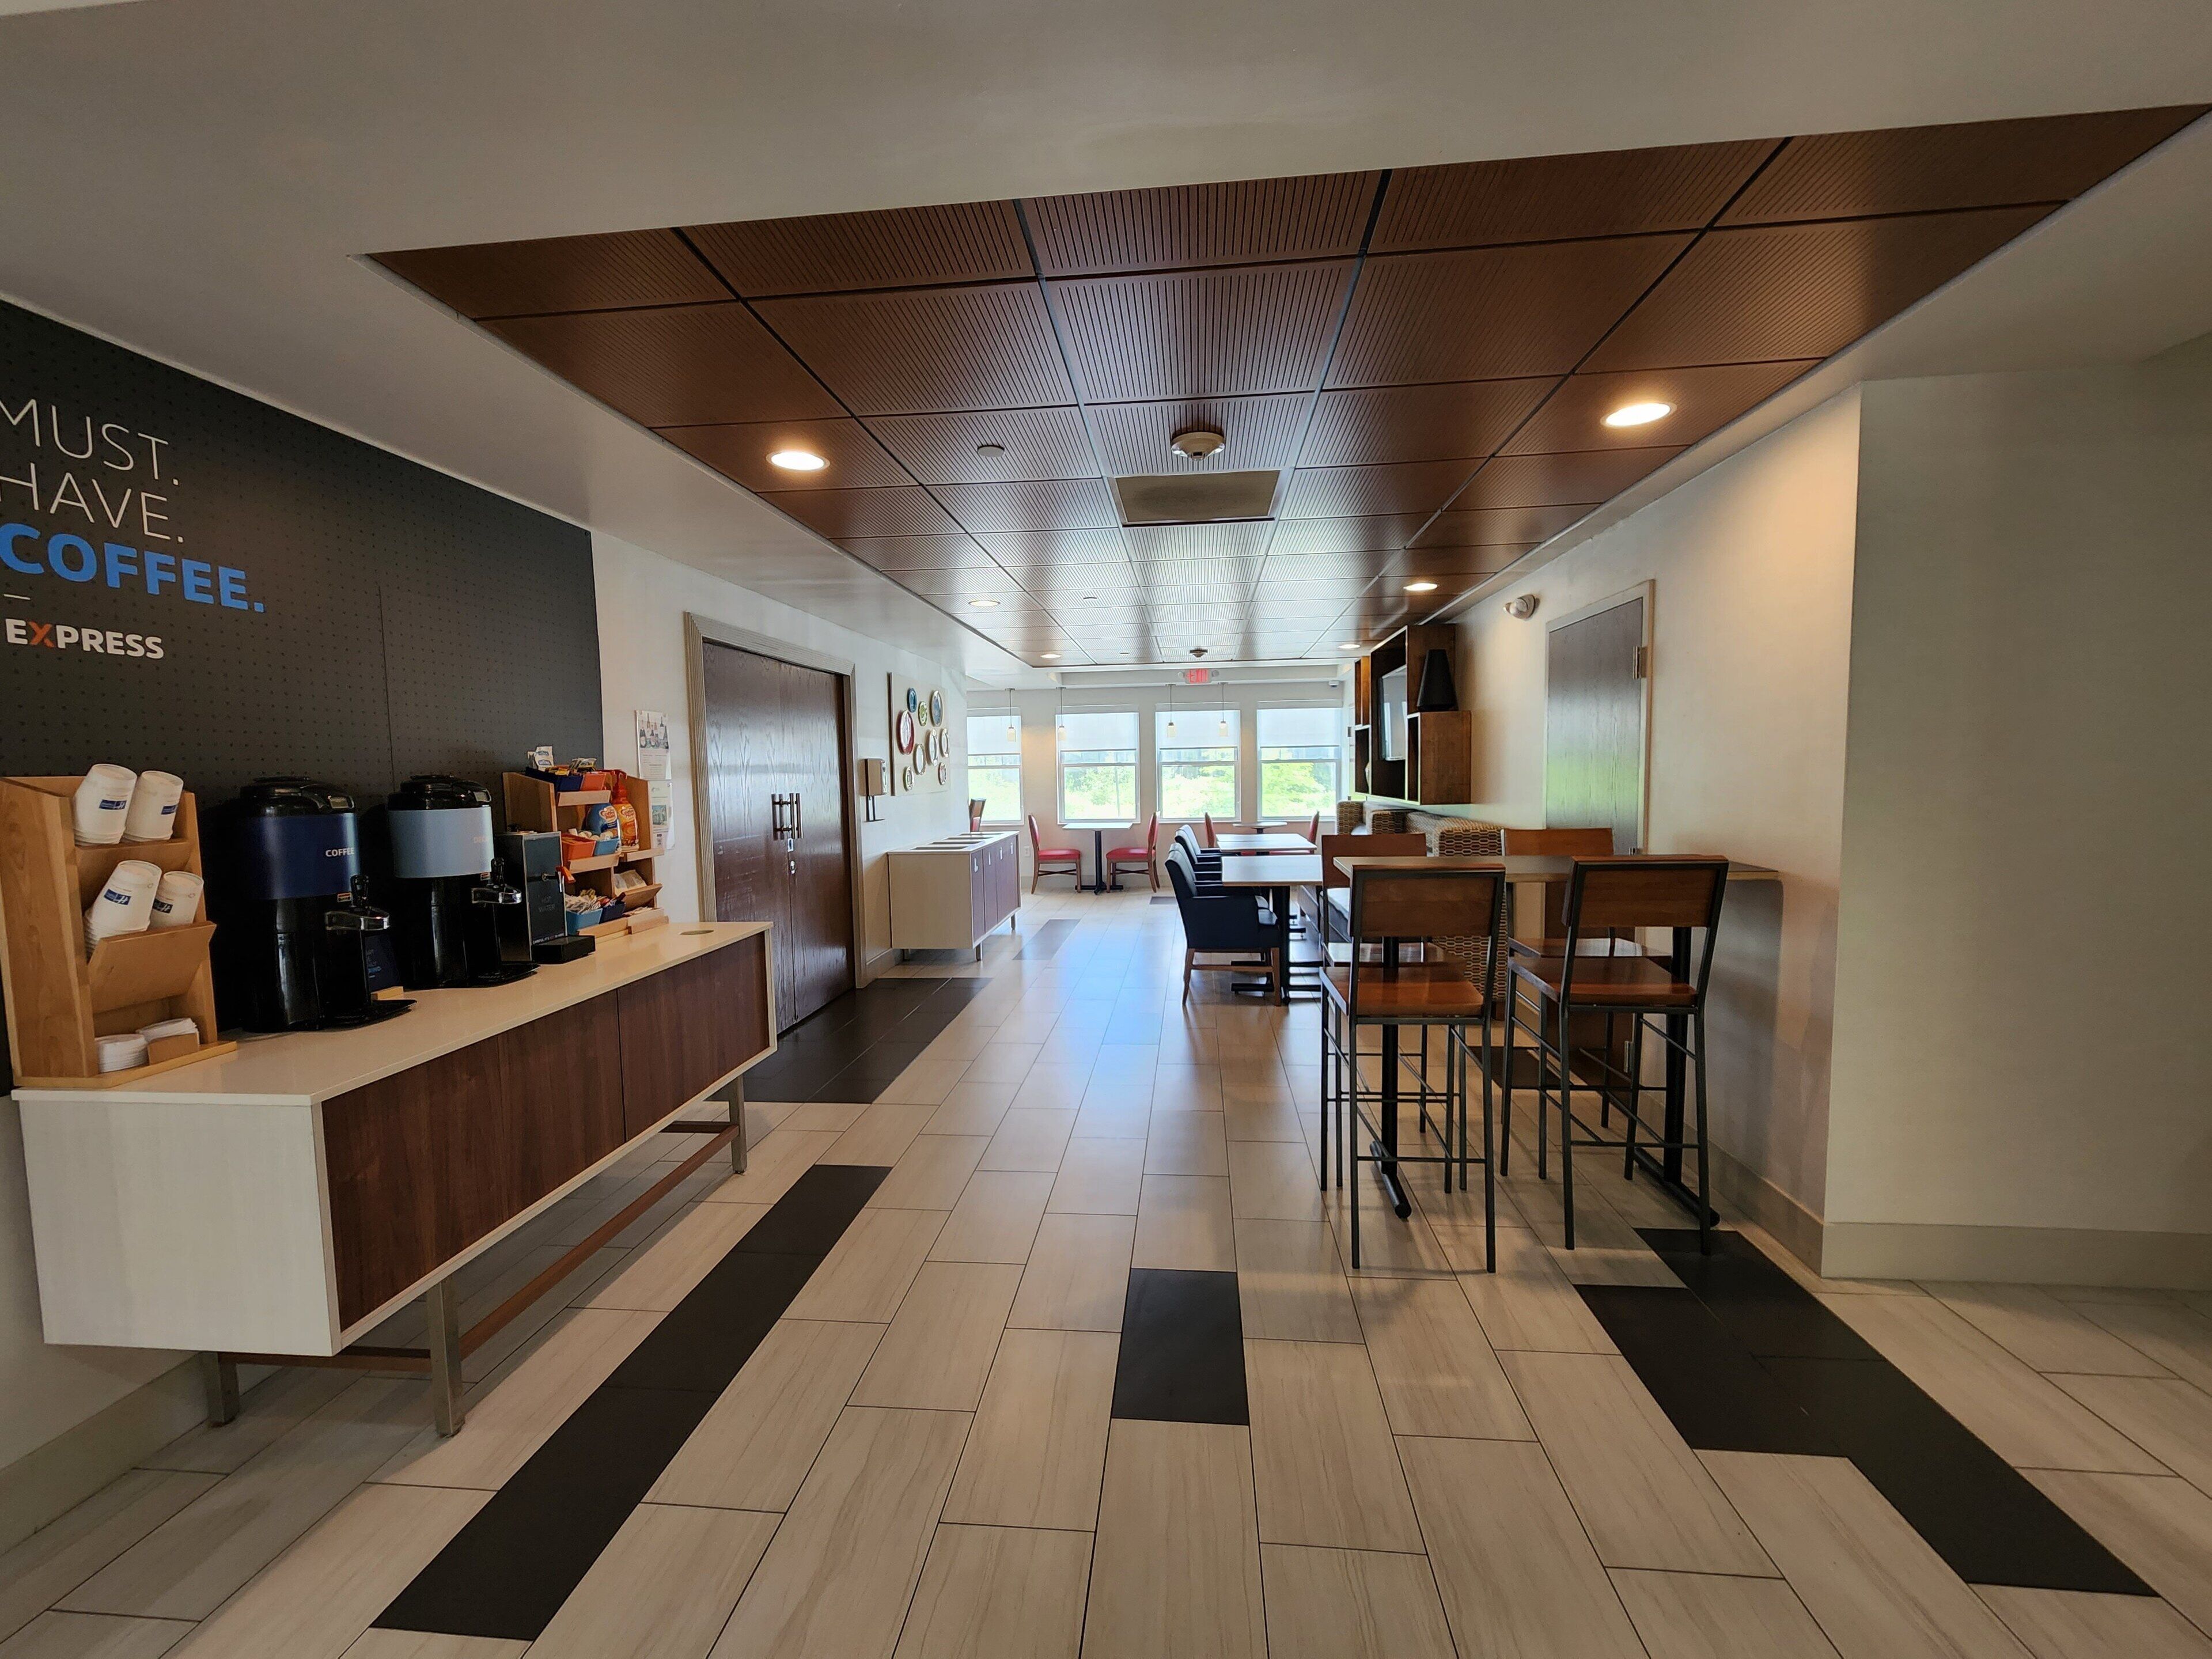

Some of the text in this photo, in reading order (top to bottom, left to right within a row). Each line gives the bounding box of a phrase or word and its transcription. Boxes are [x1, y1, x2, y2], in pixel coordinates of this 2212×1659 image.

[0, 398, 179, 486] MUST.
[0, 462, 184, 543] HAVE.
[0, 522, 265, 613] COFFEE.
[5, 618, 165, 660] EXPRESS
[325, 847, 354, 857] COFFEE
